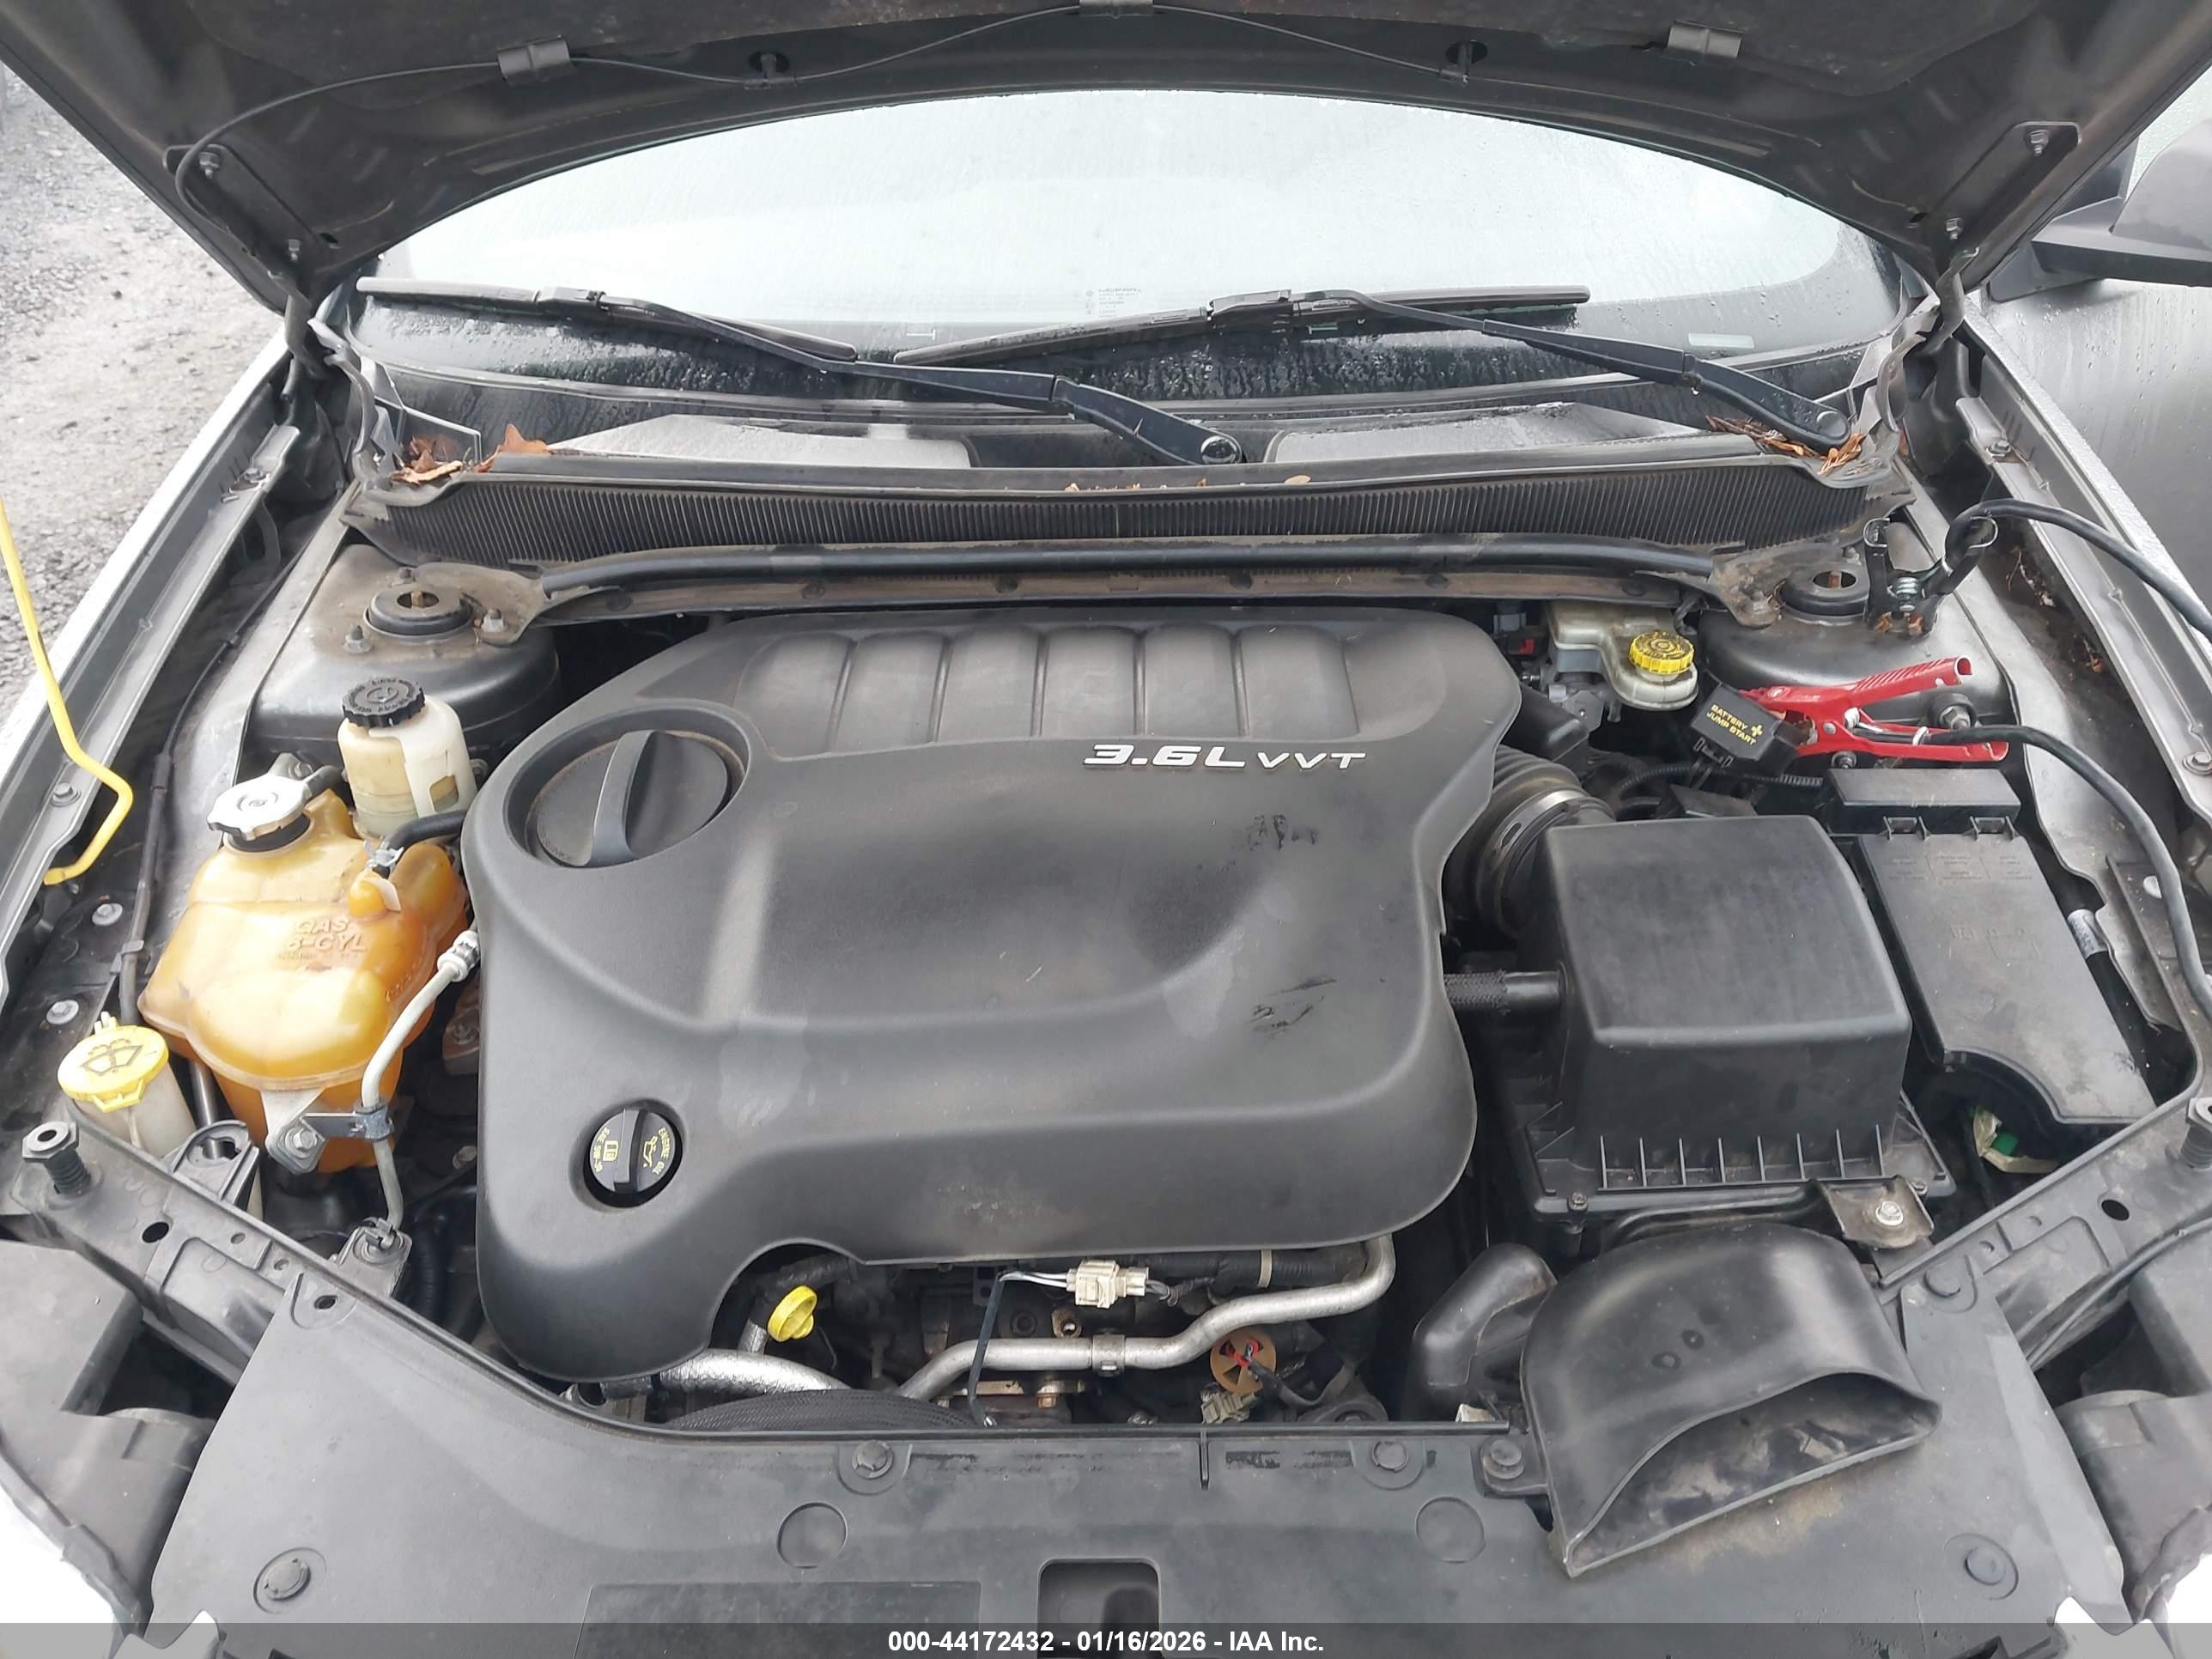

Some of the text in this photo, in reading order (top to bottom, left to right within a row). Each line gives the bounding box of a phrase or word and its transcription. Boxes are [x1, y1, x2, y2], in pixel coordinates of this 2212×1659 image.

[1083, 744, 1367, 770] 3.6L VVT
[295, 917, 350, 934] GAS
[1706, 1571, 1757, 1604] JUMP START
[1711, 1563, 1748, 1589] BATTERY
